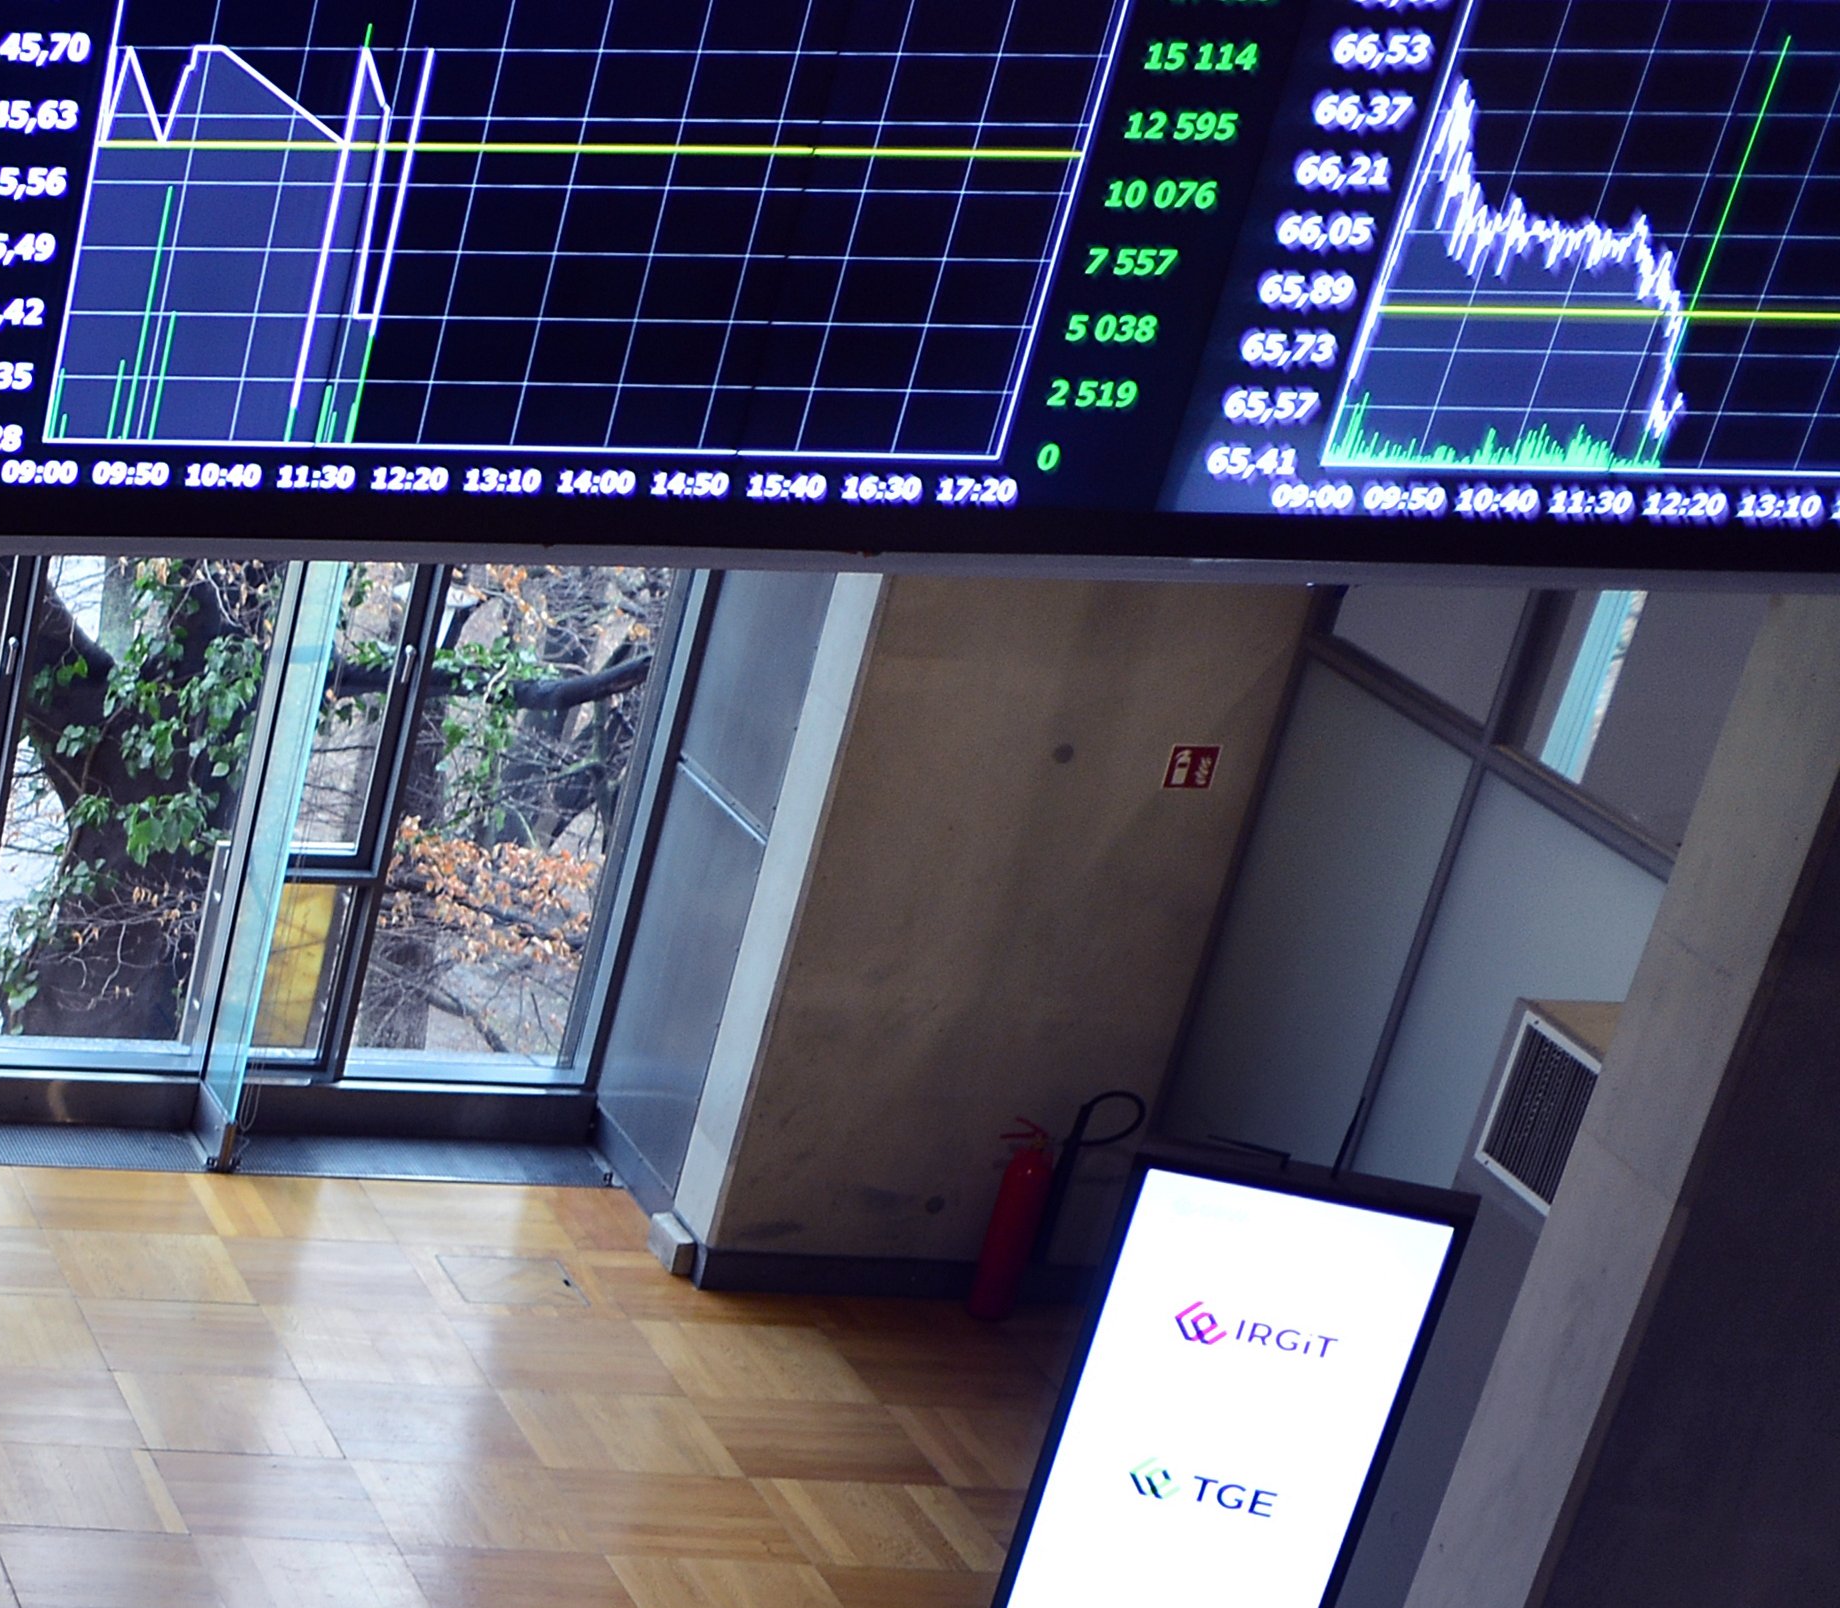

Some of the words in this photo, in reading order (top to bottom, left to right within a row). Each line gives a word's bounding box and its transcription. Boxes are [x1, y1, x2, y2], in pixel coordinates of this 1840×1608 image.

[0, 32, 91, 67] 45,70
[1144, 41, 1189, 71] 15
[1194, 42, 1258, 71] 114
[1333, 33, 1431, 69] 66,53
[1124, 110, 1168, 140] 12
[1173, 111, 1239, 142] 595
[1314, 94, 1413, 130] 66,37
[1296, 155, 1389, 190] 66,21
[1104, 179, 1148, 209] 10
[1153, 179, 1218, 210] 076
[1277, 215, 1374, 250] 66,05
[1085, 247, 1110, 275] 7
[1112, 248, 1179, 277] 557
[1259, 274, 1355, 309] 65,89
[1065, 314, 1090, 342] 5
[1094, 313, 1158, 343] 038
[1241, 332, 1336, 367] 65,73
[1047, 378, 1070, 407] 2
[1075, 380, 1138, 409] 519
[1224, 390, 1319, 424] 65,57
[1036, 443, 1061, 471] 0
[1206, 446, 1296, 479] 65,41
[1, 459, 78, 484] 09:00
[92, 460, 170, 486] 09:50
[185, 462, 262, 488] 10:40
[276, 464, 356, 490] 11:30
[370, 466, 449, 491] 12:20
[463, 467, 542, 493] 13:10
[557, 469, 636, 495] 14:00
[650, 471, 730, 496] 14:50
[746, 474, 827, 499] 15:40
[841, 475, 922, 501] 16:30
[936, 477, 1017, 503] 17:20
[1271, 483, 1354, 510] 09:00
[1363, 485, 1446, 512] 09:50
[1455, 487, 1539, 513] 10:40
[1548, 490, 1633, 515] 11:30
[1642, 491, 1727, 517] 12:20
[1737, 494, 1822, 519] 13:10
[1235, 1319, 1339, 1359] IRGiT
[1193, 1474, 1279, 1519] TGE
